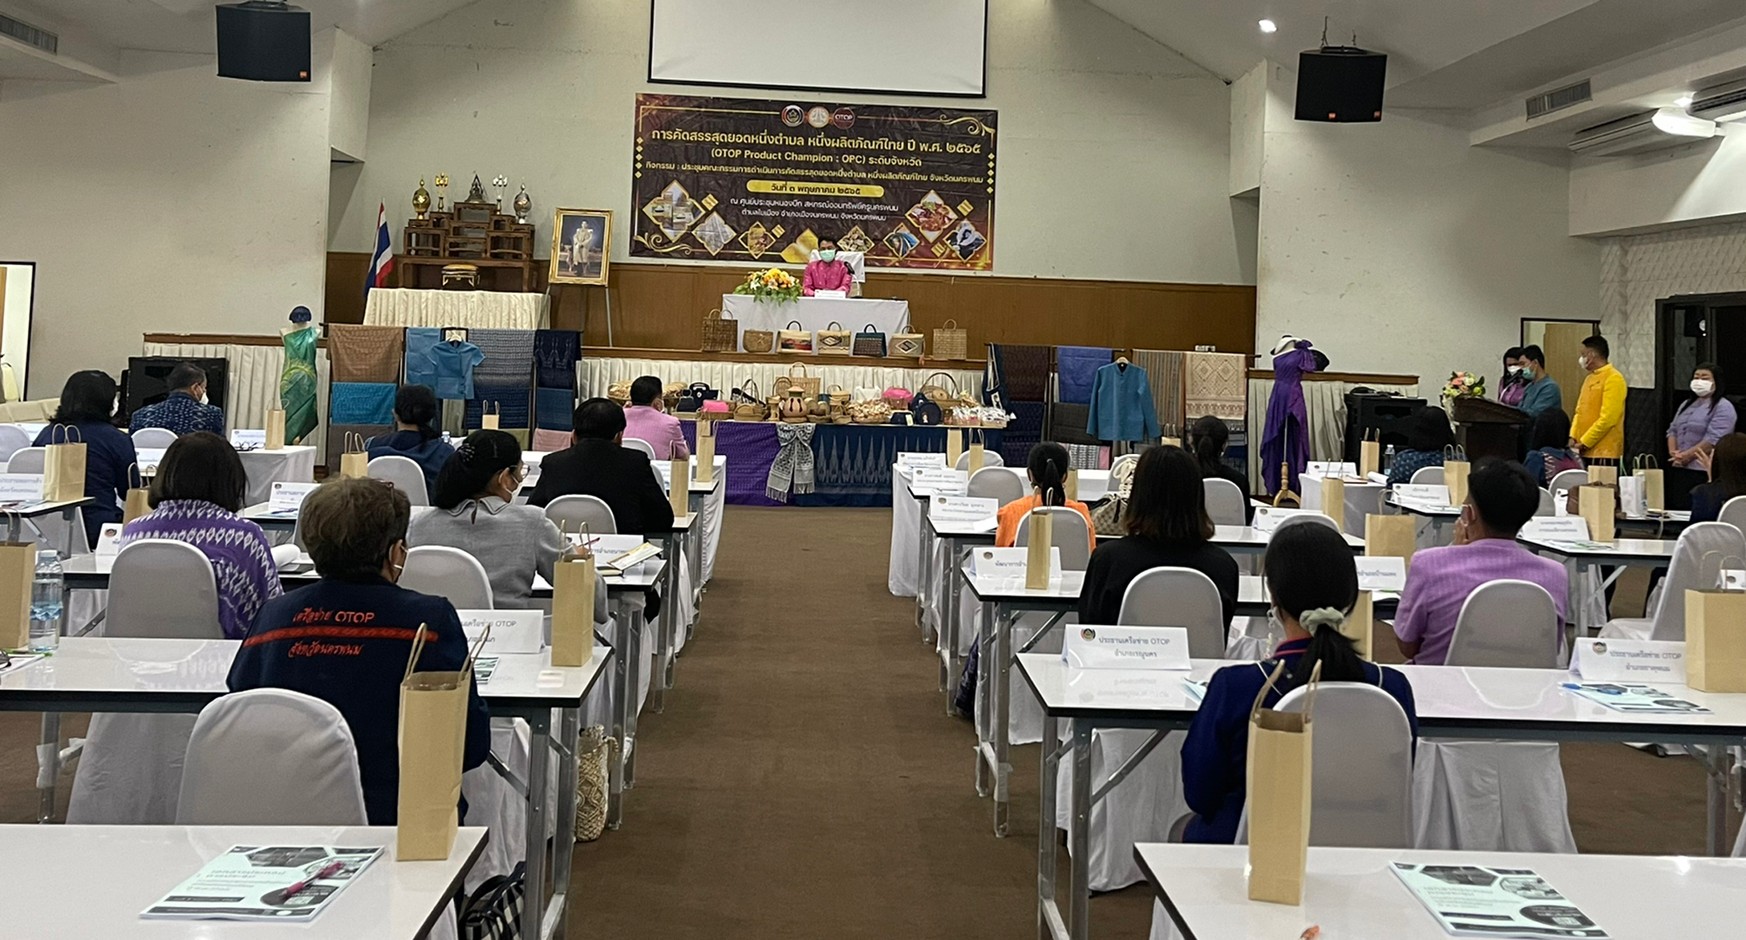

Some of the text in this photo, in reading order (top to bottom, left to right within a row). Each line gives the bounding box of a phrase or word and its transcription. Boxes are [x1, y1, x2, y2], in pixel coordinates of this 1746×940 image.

[652, 128, 804, 146] การคัดสรรสุดยอดหนึ่งตำบล
[807, 131, 904, 151] หนึ่งผลิตภัณฑ์ไทย
[907, 138, 916, 151] ปี
[711, 148, 741, 159] (OTOP
[744, 148, 782, 160] Product
[784, 151, 833, 163] Champion
[841, 154, 866, 165] OPC)
[868, 154, 922, 166] ระดับจังหวัด
[645, 161, 675, 170] กิจกรรม
[771, 181, 787, 192] วันที่
[797, 186, 835, 194] พฤษภาคม
[334, 611, 376, 623] OTOP
